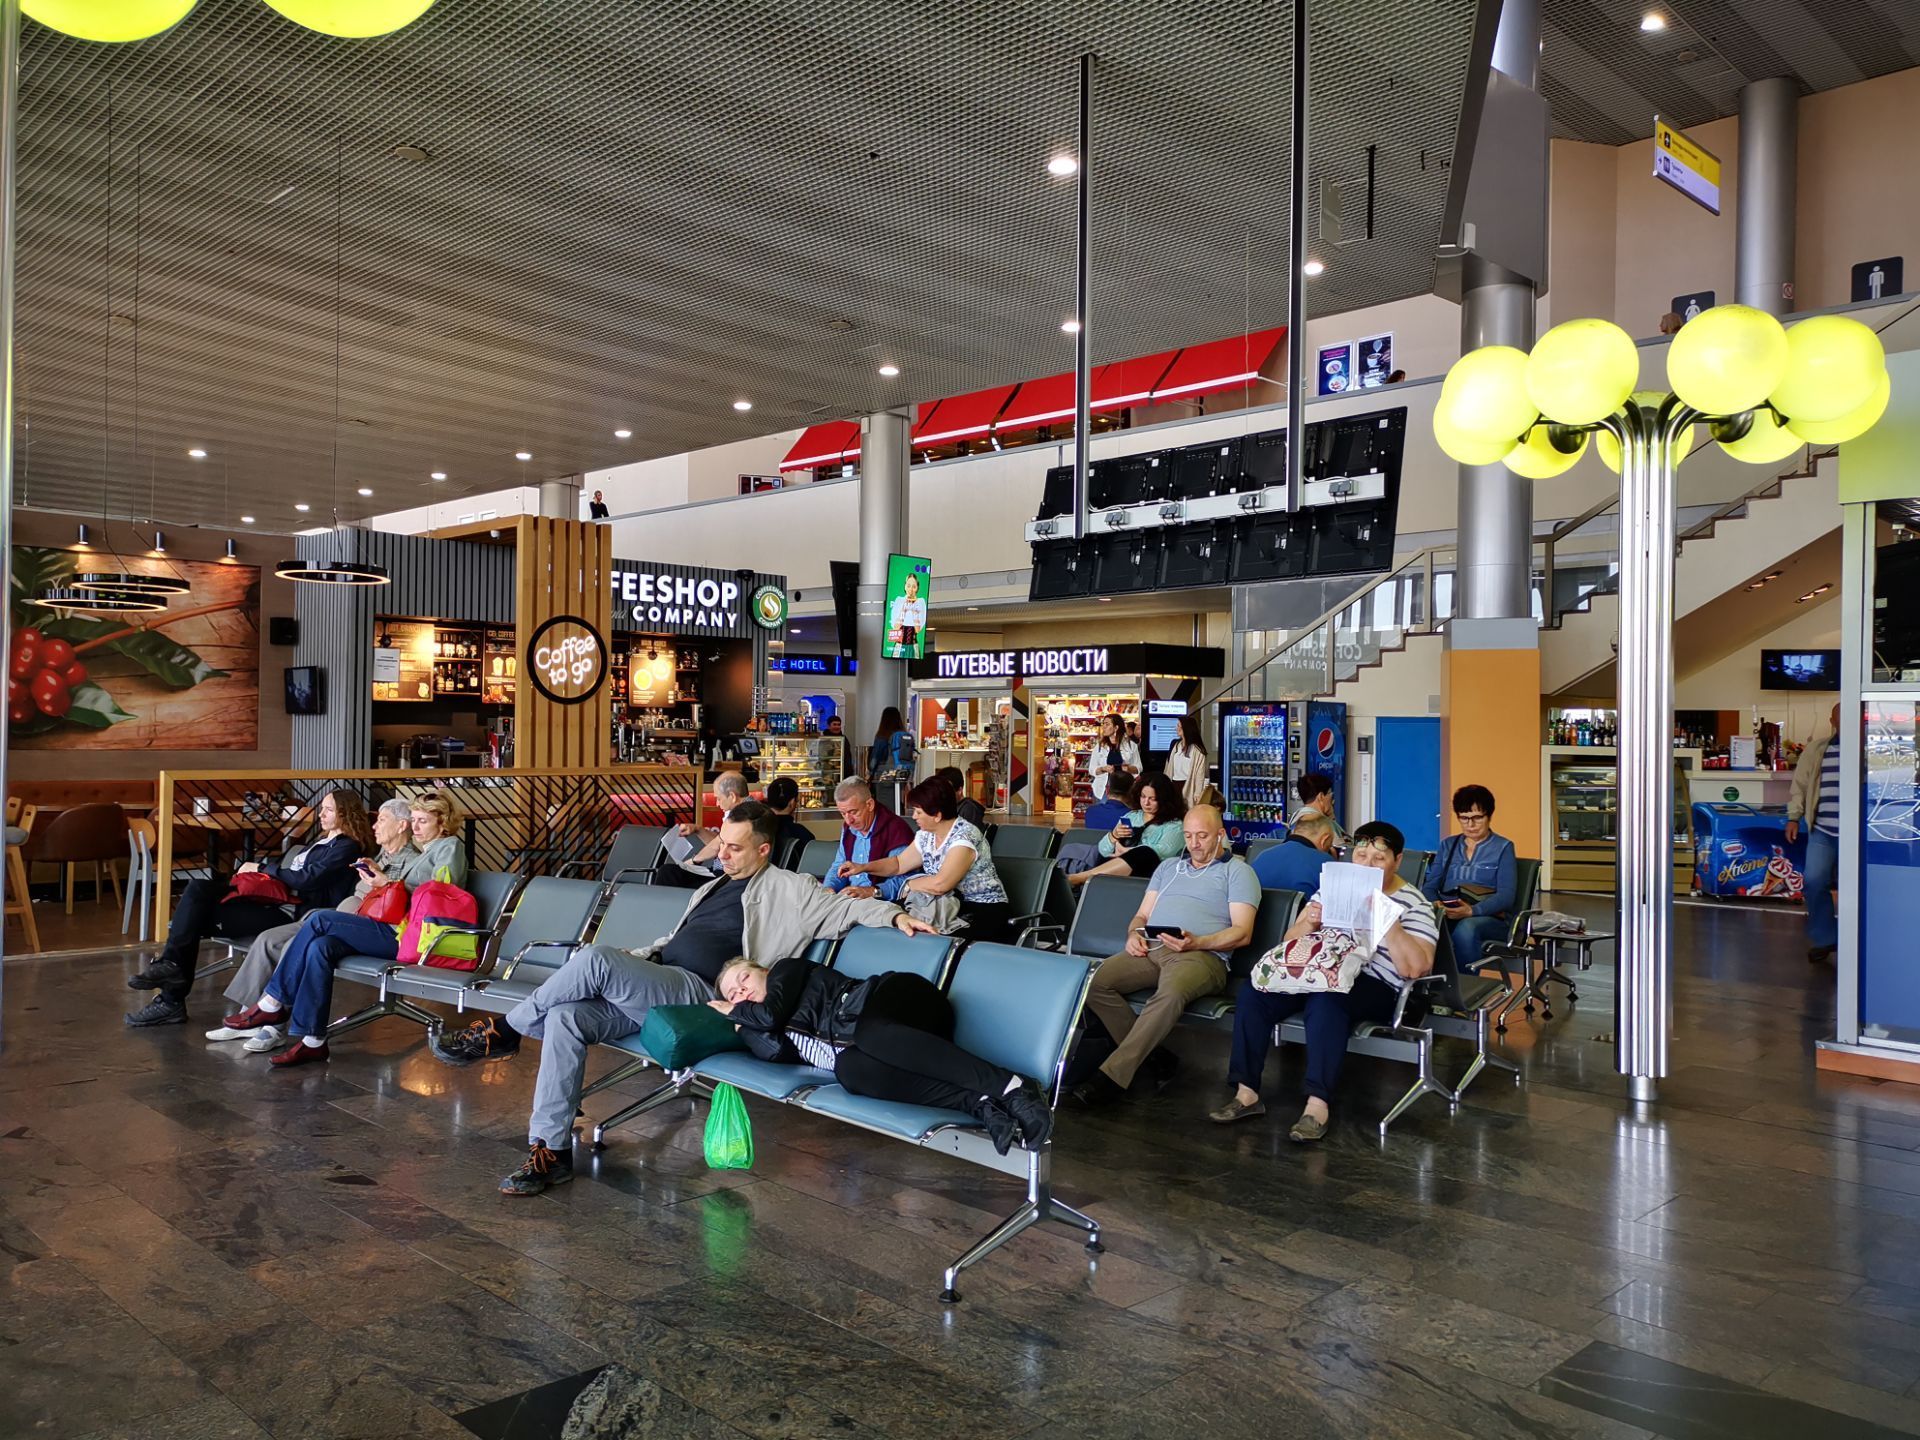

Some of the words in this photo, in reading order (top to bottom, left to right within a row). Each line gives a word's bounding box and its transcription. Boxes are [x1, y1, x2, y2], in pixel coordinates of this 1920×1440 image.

[632, 605, 738, 628] COMPANY
[759, 616, 783, 628] COMPANY
[535, 635, 596, 669] Coffee
[938, 652, 1016, 677] ПУТЕВЫЕ
[1022, 649, 1107, 674] НОВОСТИ
[548, 668, 568, 686] to
[571, 658, 592, 685] go
[789, 660, 827, 670] HOTEL
